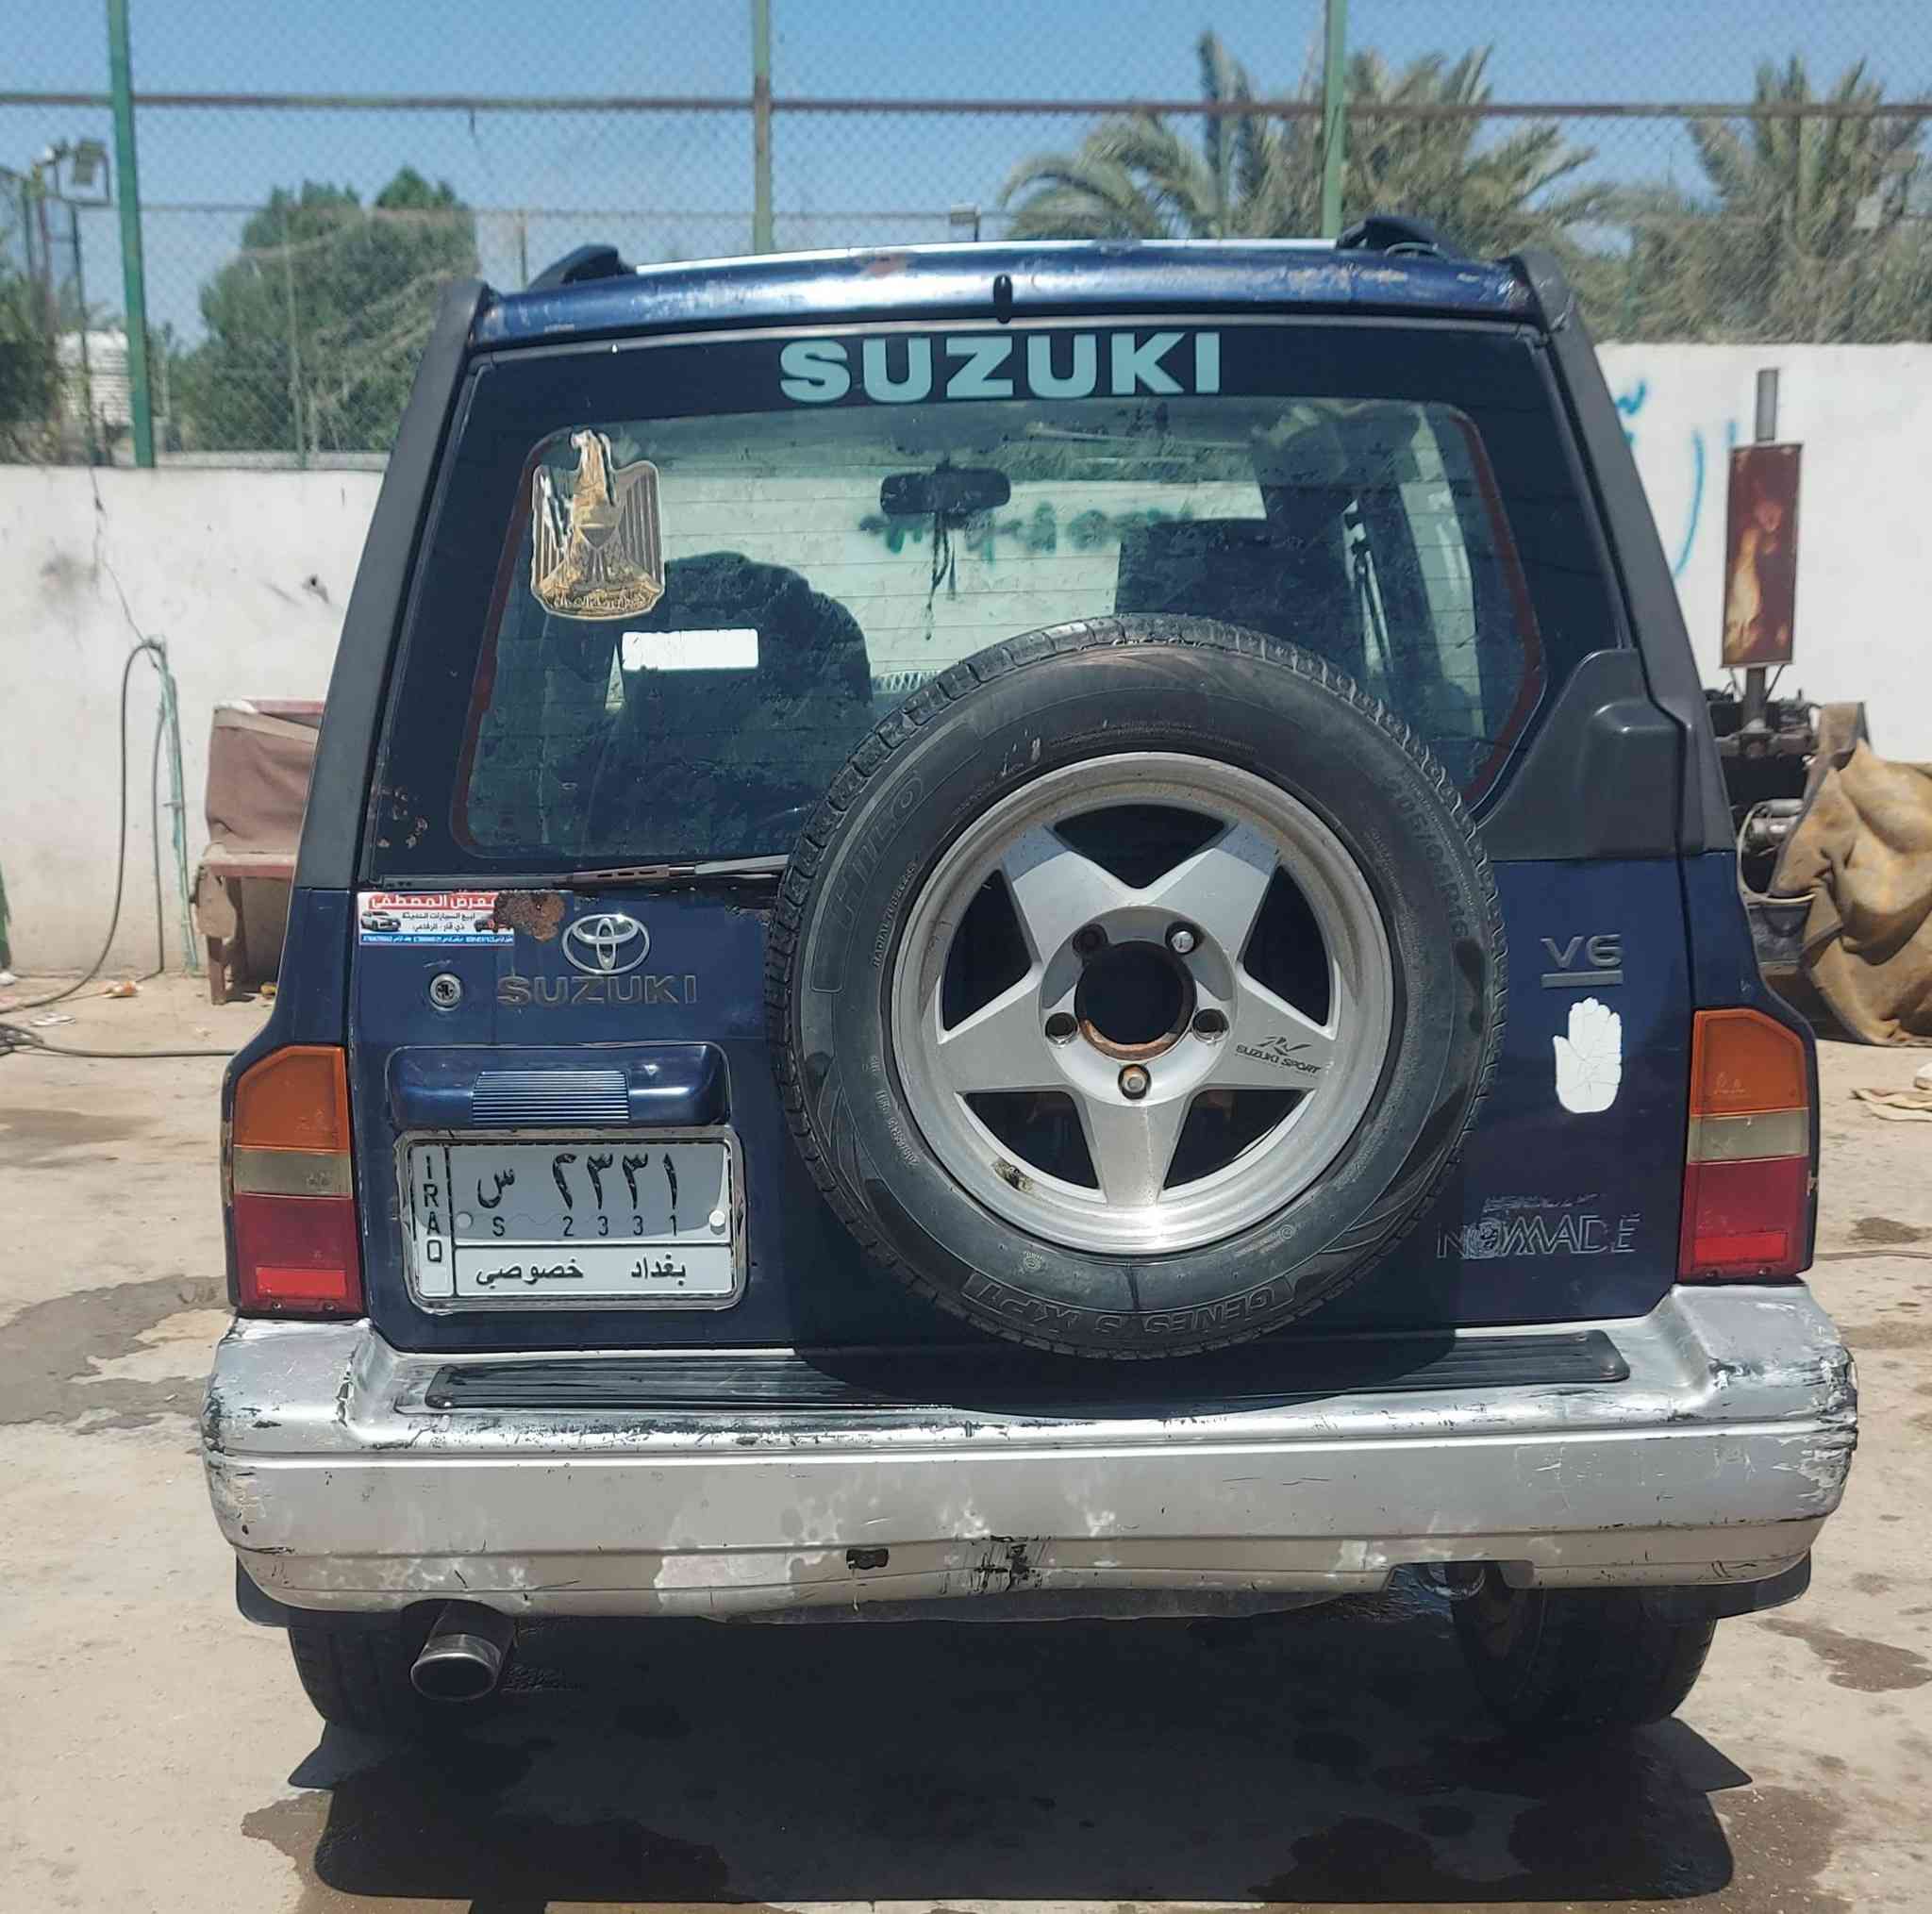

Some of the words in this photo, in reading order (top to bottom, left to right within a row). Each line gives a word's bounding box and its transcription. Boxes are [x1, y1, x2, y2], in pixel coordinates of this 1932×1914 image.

[779, 331, 1221, 404] SUZUKI
[450, 893, 498, 909] عرض
[1540, 933, 1622, 969] V6
[497, 974, 698, 1006] SUZUKI
[1236, 1044, 1280, 1064] SUZUKI
[1281, 1057, 1322, 1074] SPORT
[477, 1168, 516, 1209] س
[552, 1152, 678, 1210] ٢٣٣١
[492, 1217, 506, 1238] S
[562, 1213, 678, 1238] 2331
[475, 1258, 584, 1290] خصوصي
[630, 1254, 687, 1286] بغداد
